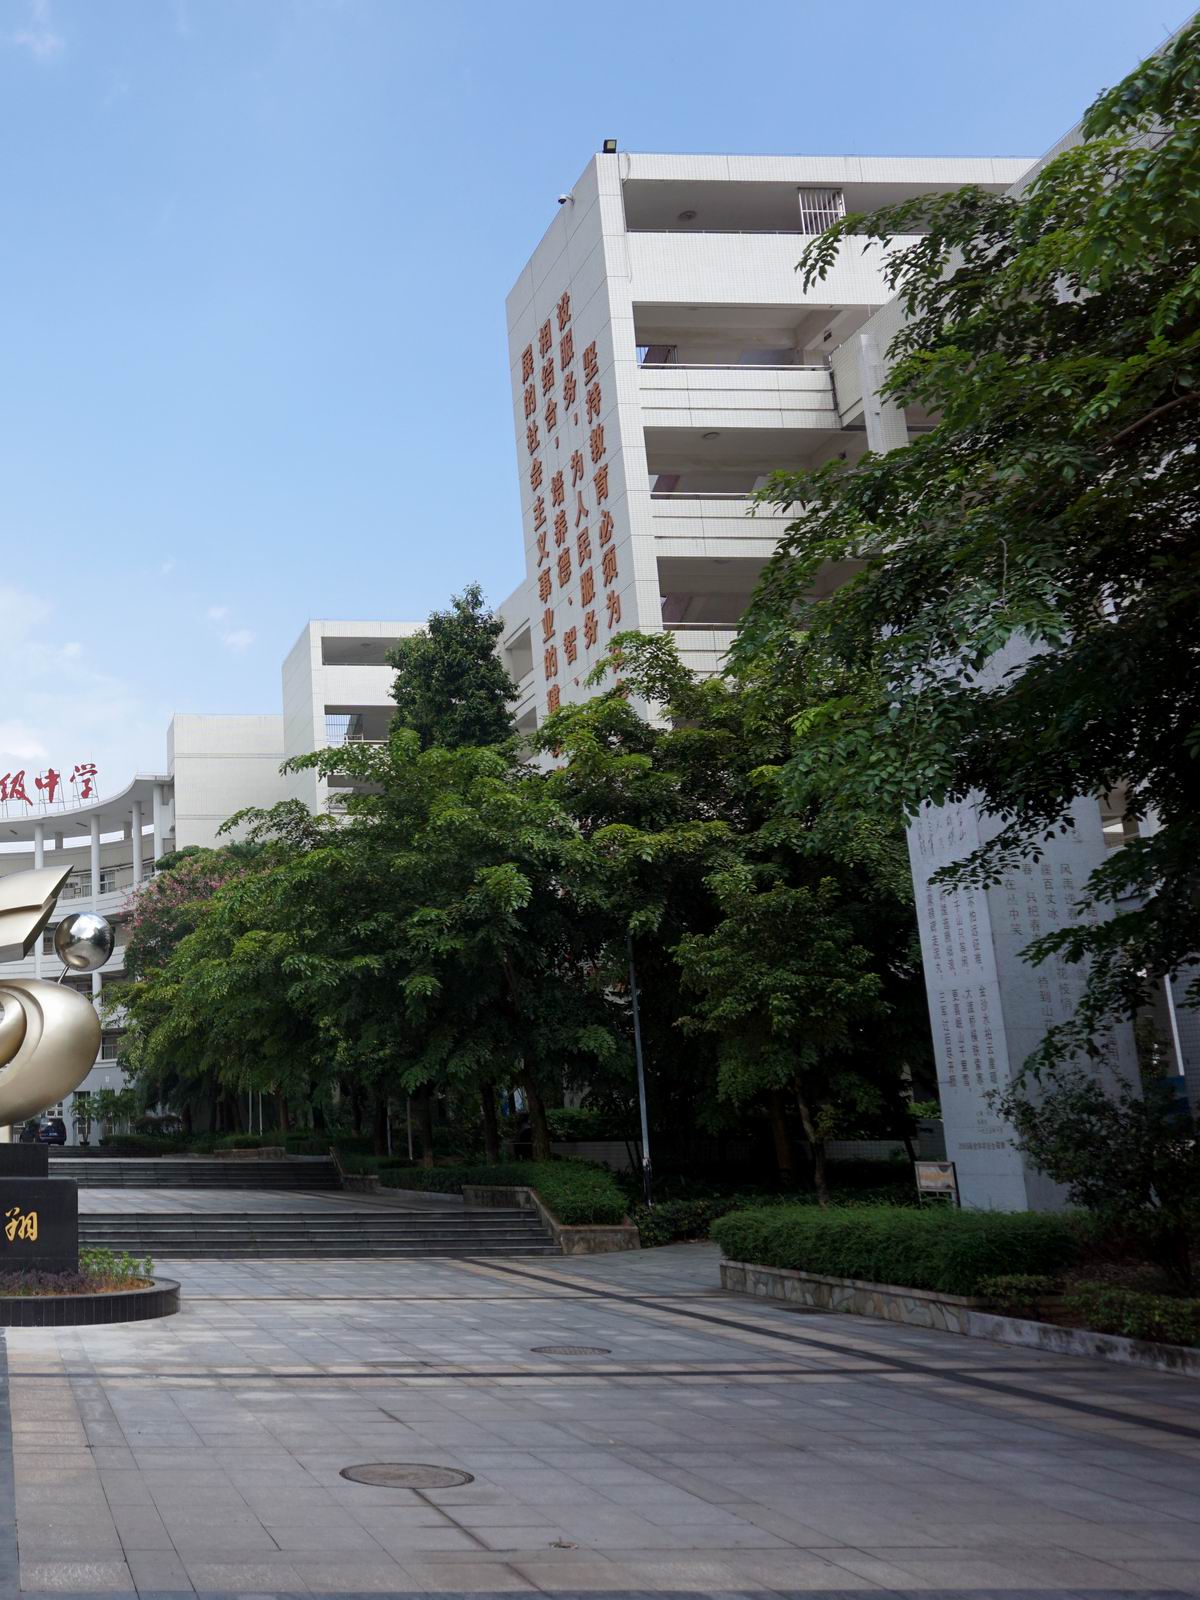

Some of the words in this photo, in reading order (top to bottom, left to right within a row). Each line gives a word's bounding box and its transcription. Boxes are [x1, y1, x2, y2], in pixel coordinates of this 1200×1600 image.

[583, 340, 628, 700] 坚持教育必须为
